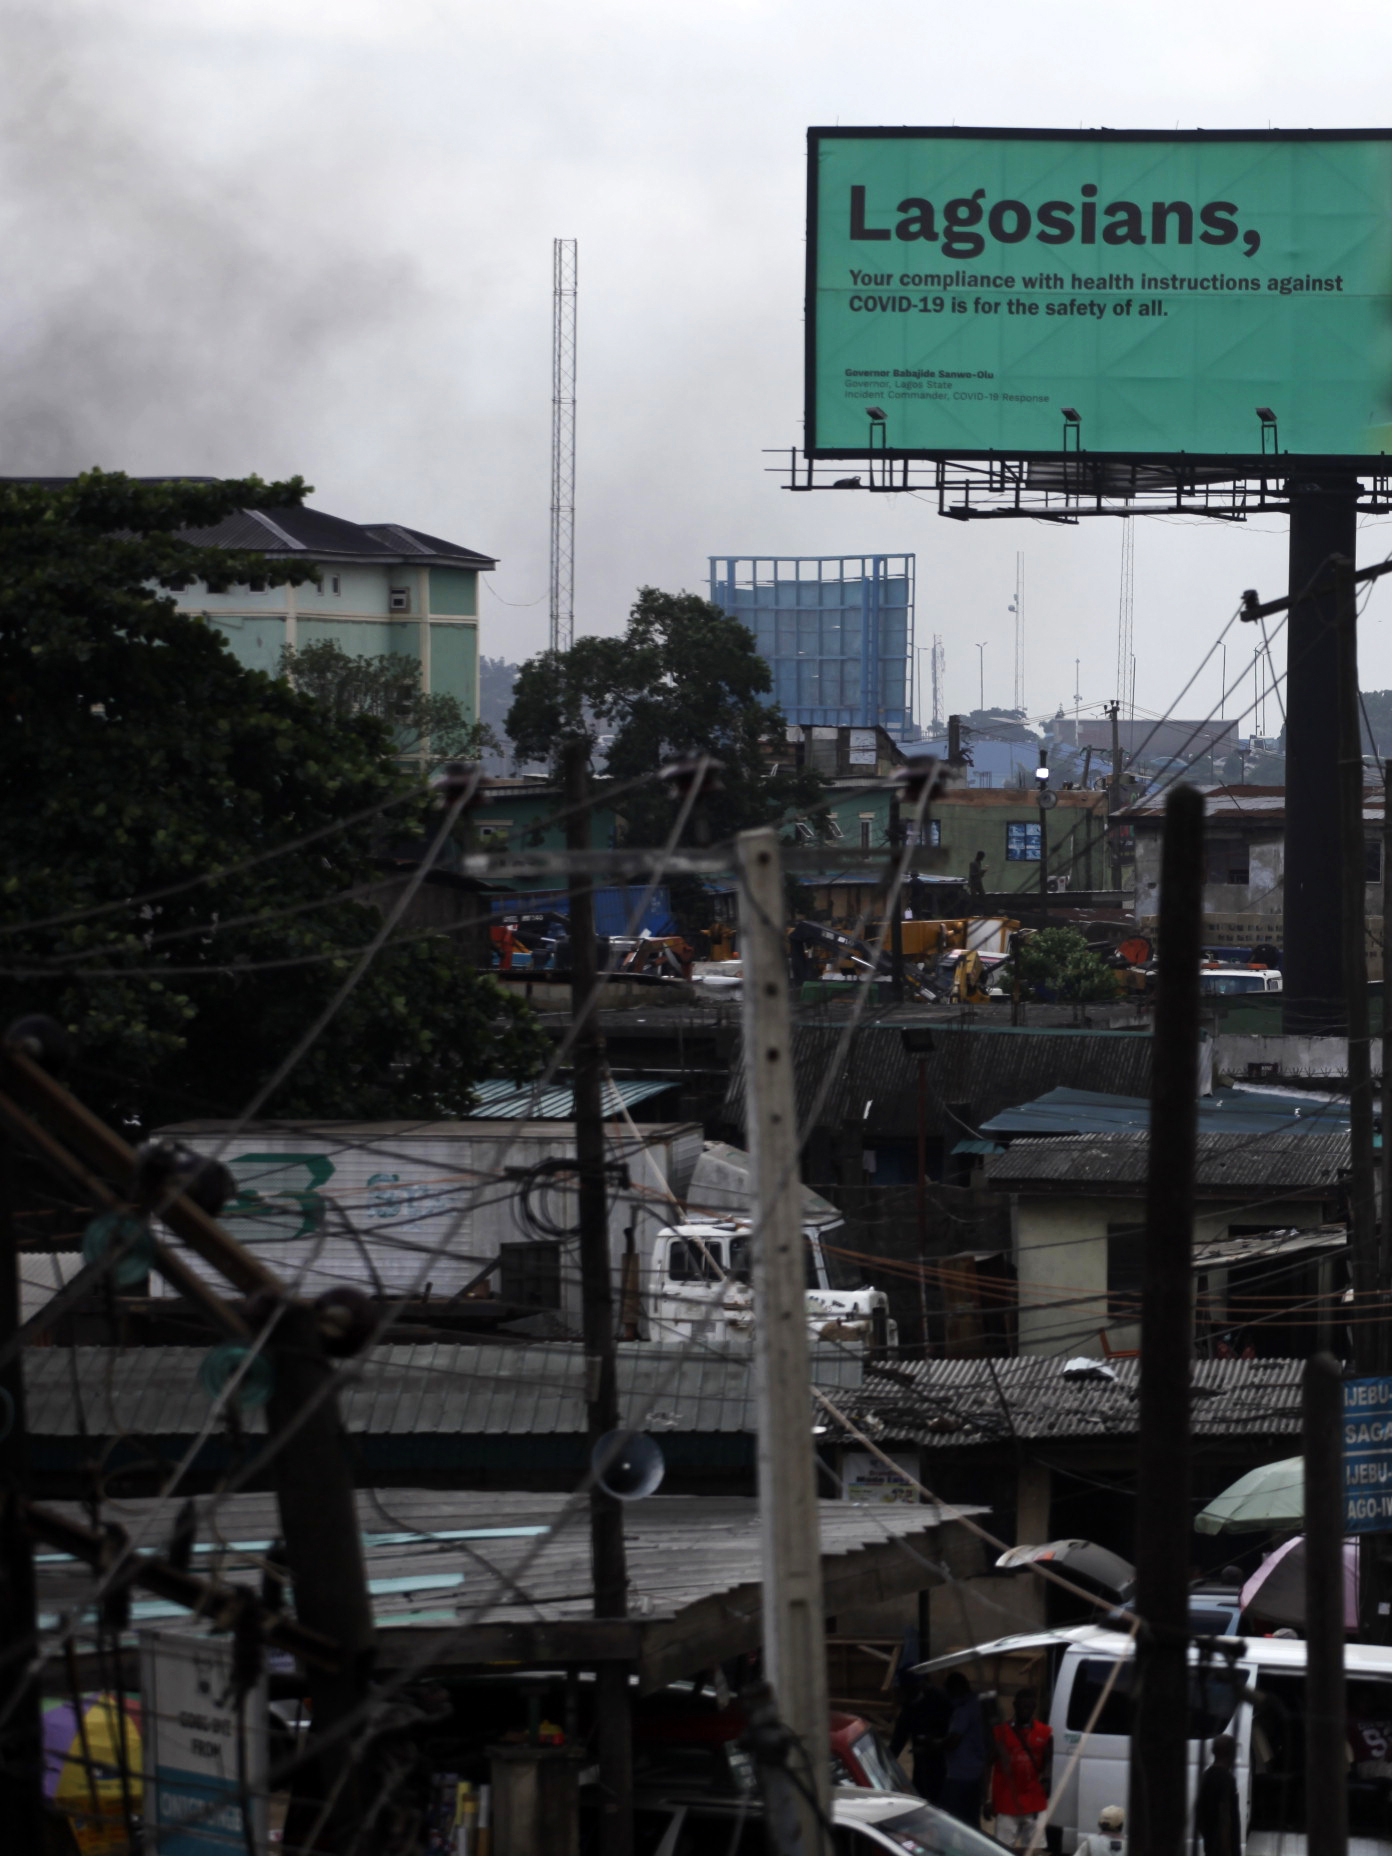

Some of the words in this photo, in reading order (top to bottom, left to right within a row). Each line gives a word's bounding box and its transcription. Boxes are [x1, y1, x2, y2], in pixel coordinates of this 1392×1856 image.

[850, 184, 1260, 259] Lagosians,
[850, 270, 893, 286] Your
[900, 271, 1015, 291] compliance
[1022, 273, 1064, 289] with
[1072, 274, 1133, 290] health
[1142, 273, 1260, 290] instructions
[1268, 275, 1343, 295] against
[849, 295, 944, 313] COVID-19
[952, 297, 967, 313] is
[974, 297, 1001, 314] for
[1007, 299, 1039, 315] the
[1046, 299, 1106, 319] safety
[1113, 299, 1132, 315] of
[1139, 300, 1167, 316] all.
[845, 369, 890, 377] Governor
[893, 369, 935, 379] Babajide
[939, 370, 994, 379] Sanwo-Olu
[845, 379, 891, 388] Governor,
[895, 379, 923, 390] Lagos
[927, 381, 952, 389] State
[888, 391, 949, 400] Commander,
[953, 392, 1000, 401] COVID-19
[1001, 393, 1049, 403] Response
